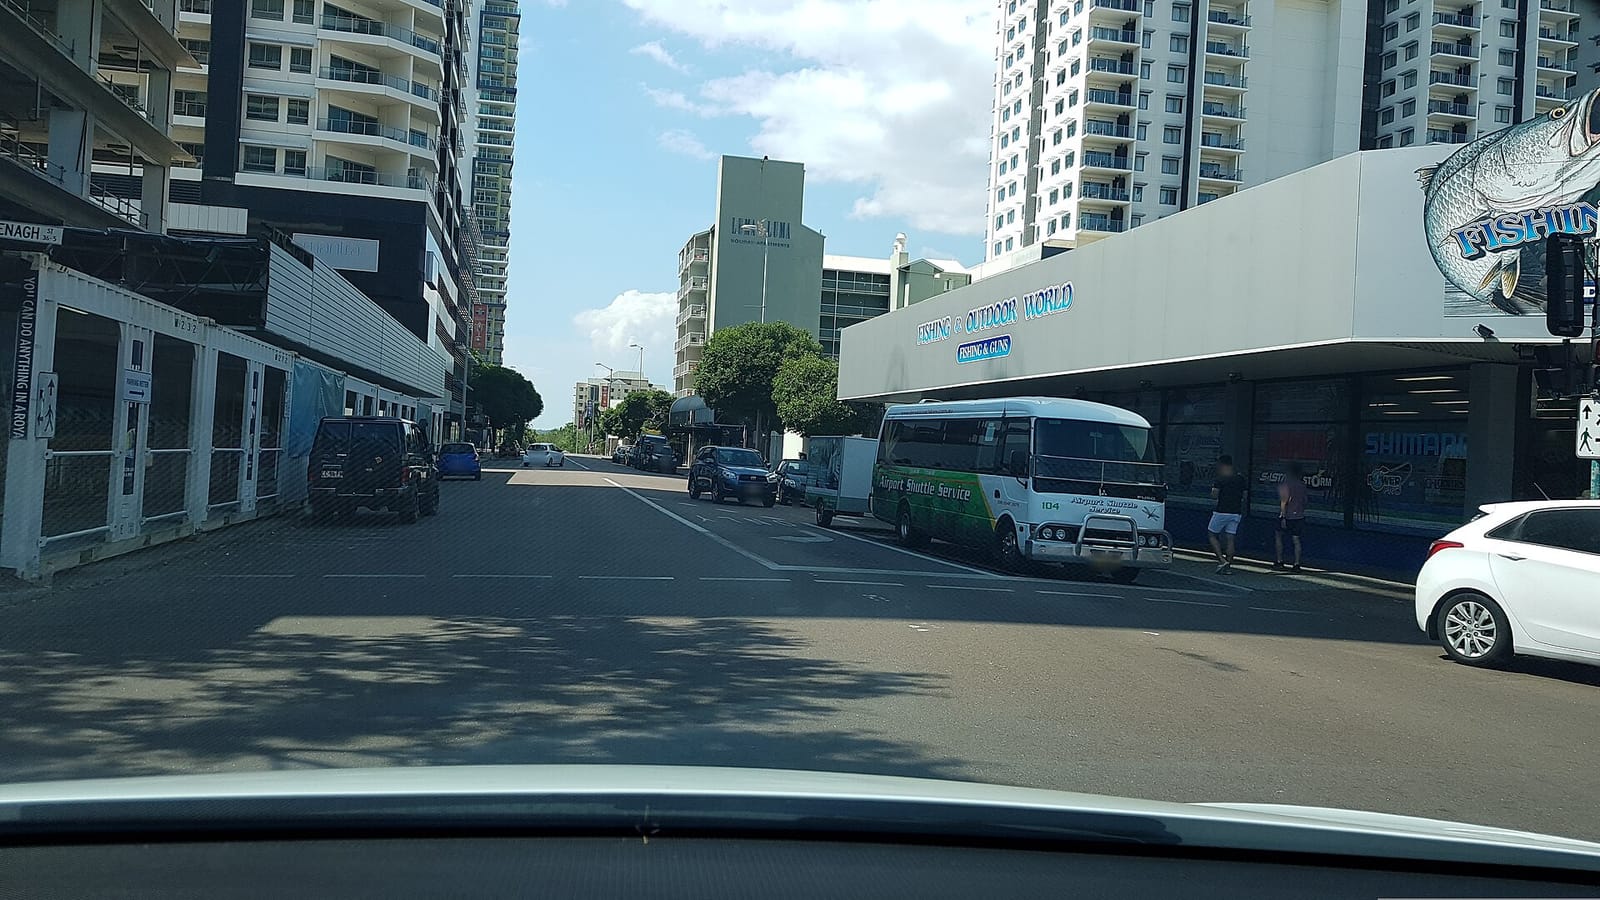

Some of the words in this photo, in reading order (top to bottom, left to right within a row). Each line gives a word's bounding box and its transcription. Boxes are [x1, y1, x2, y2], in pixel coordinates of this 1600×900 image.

[767, 220, 791, 239] LUMA
[21, 300, 34, 320] CAN
[917, 316, 951, 345] FISHING
[965, 297, 1018, 334] OUTDOOR
[1023, 281, 1074, 321] WORLD
[20, 322, 33, 337] DO
[960, 343, 983, 360] FISHING
[989, 338, 1009, 354] GUNS
[16, 338, 32, 389] ANYTHING
[15, 391, 28, 403] IN
[879, 475, 904, 492] Airport
[906, 478, 935, 495] Shuttle
[937, 482, 971, 501] Service
[1303, 474, 1332, 488] STORM
[1041, 501, 1060, 511] 104
